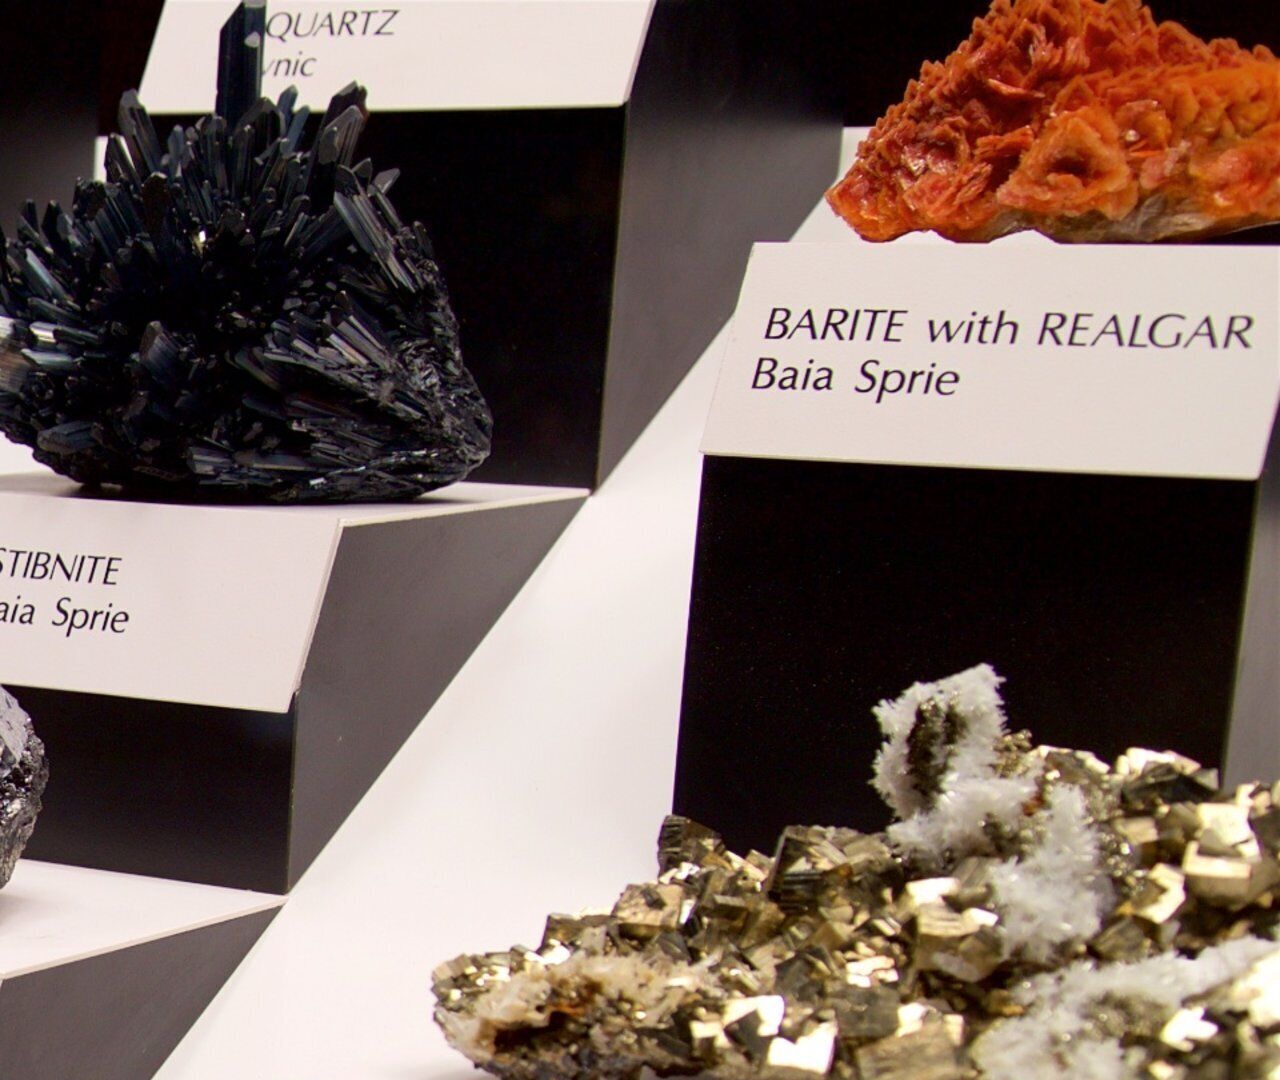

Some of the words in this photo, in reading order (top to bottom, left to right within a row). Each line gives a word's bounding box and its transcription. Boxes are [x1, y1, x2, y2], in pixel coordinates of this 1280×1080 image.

[266, 10, 399, 42] QUARTZ
[763, 307, 909, 343] BARITE
[927, 309, 1020, 345] with
[1037, 312, 1254, 350] REALGAR
[751, 356, 834, 392] Baia
[853, 359, 961, 405] Sprie
[51, 596, 130, 638] Sprie
